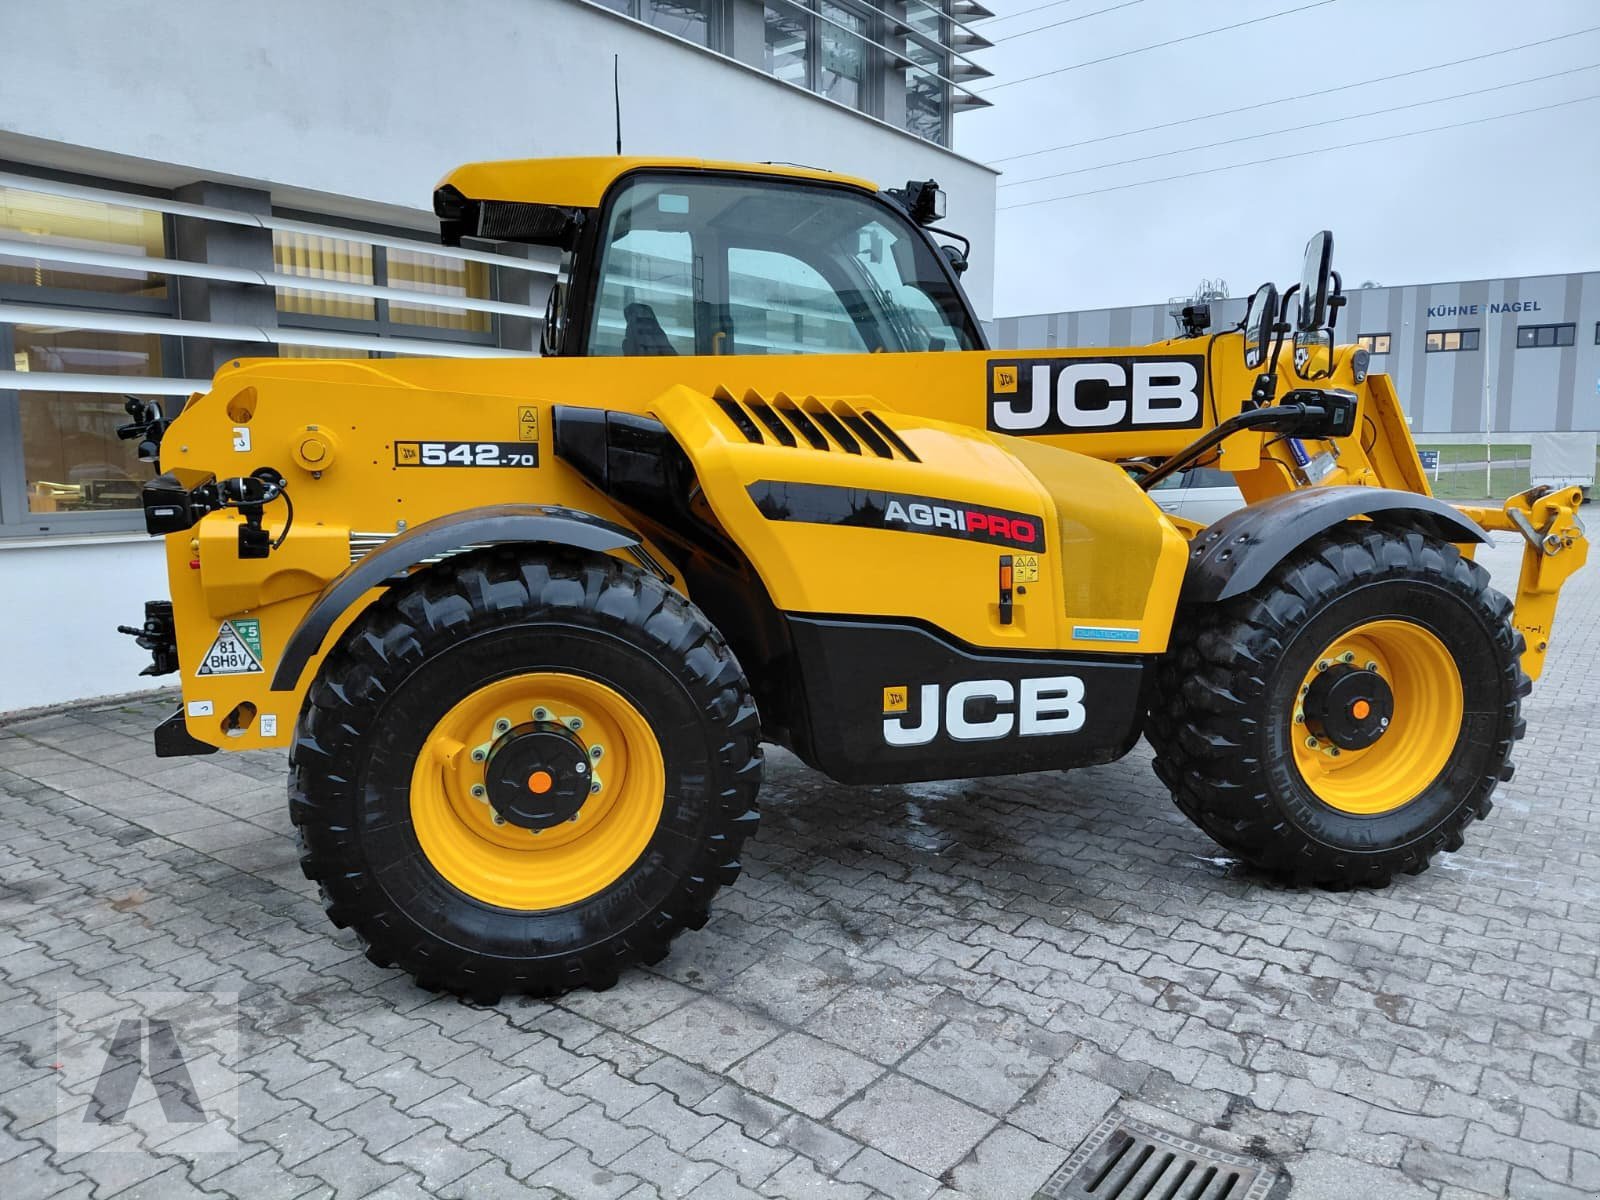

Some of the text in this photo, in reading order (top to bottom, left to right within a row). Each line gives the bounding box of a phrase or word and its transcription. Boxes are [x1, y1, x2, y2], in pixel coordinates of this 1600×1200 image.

[1427, 301, 1542, 317] KÜHNE NAGEL
[993, 361, 1199, 430] JCB
[422, 443, 534, 466] 542-70
[885, 500, 1036, 543] AGRIPRO
[248, 626, 258, 637] 5
[220, 641, 236, 654] 81
[211, 654, 247, 668] BH8V
[883, 676, 1087, 747] JCB
